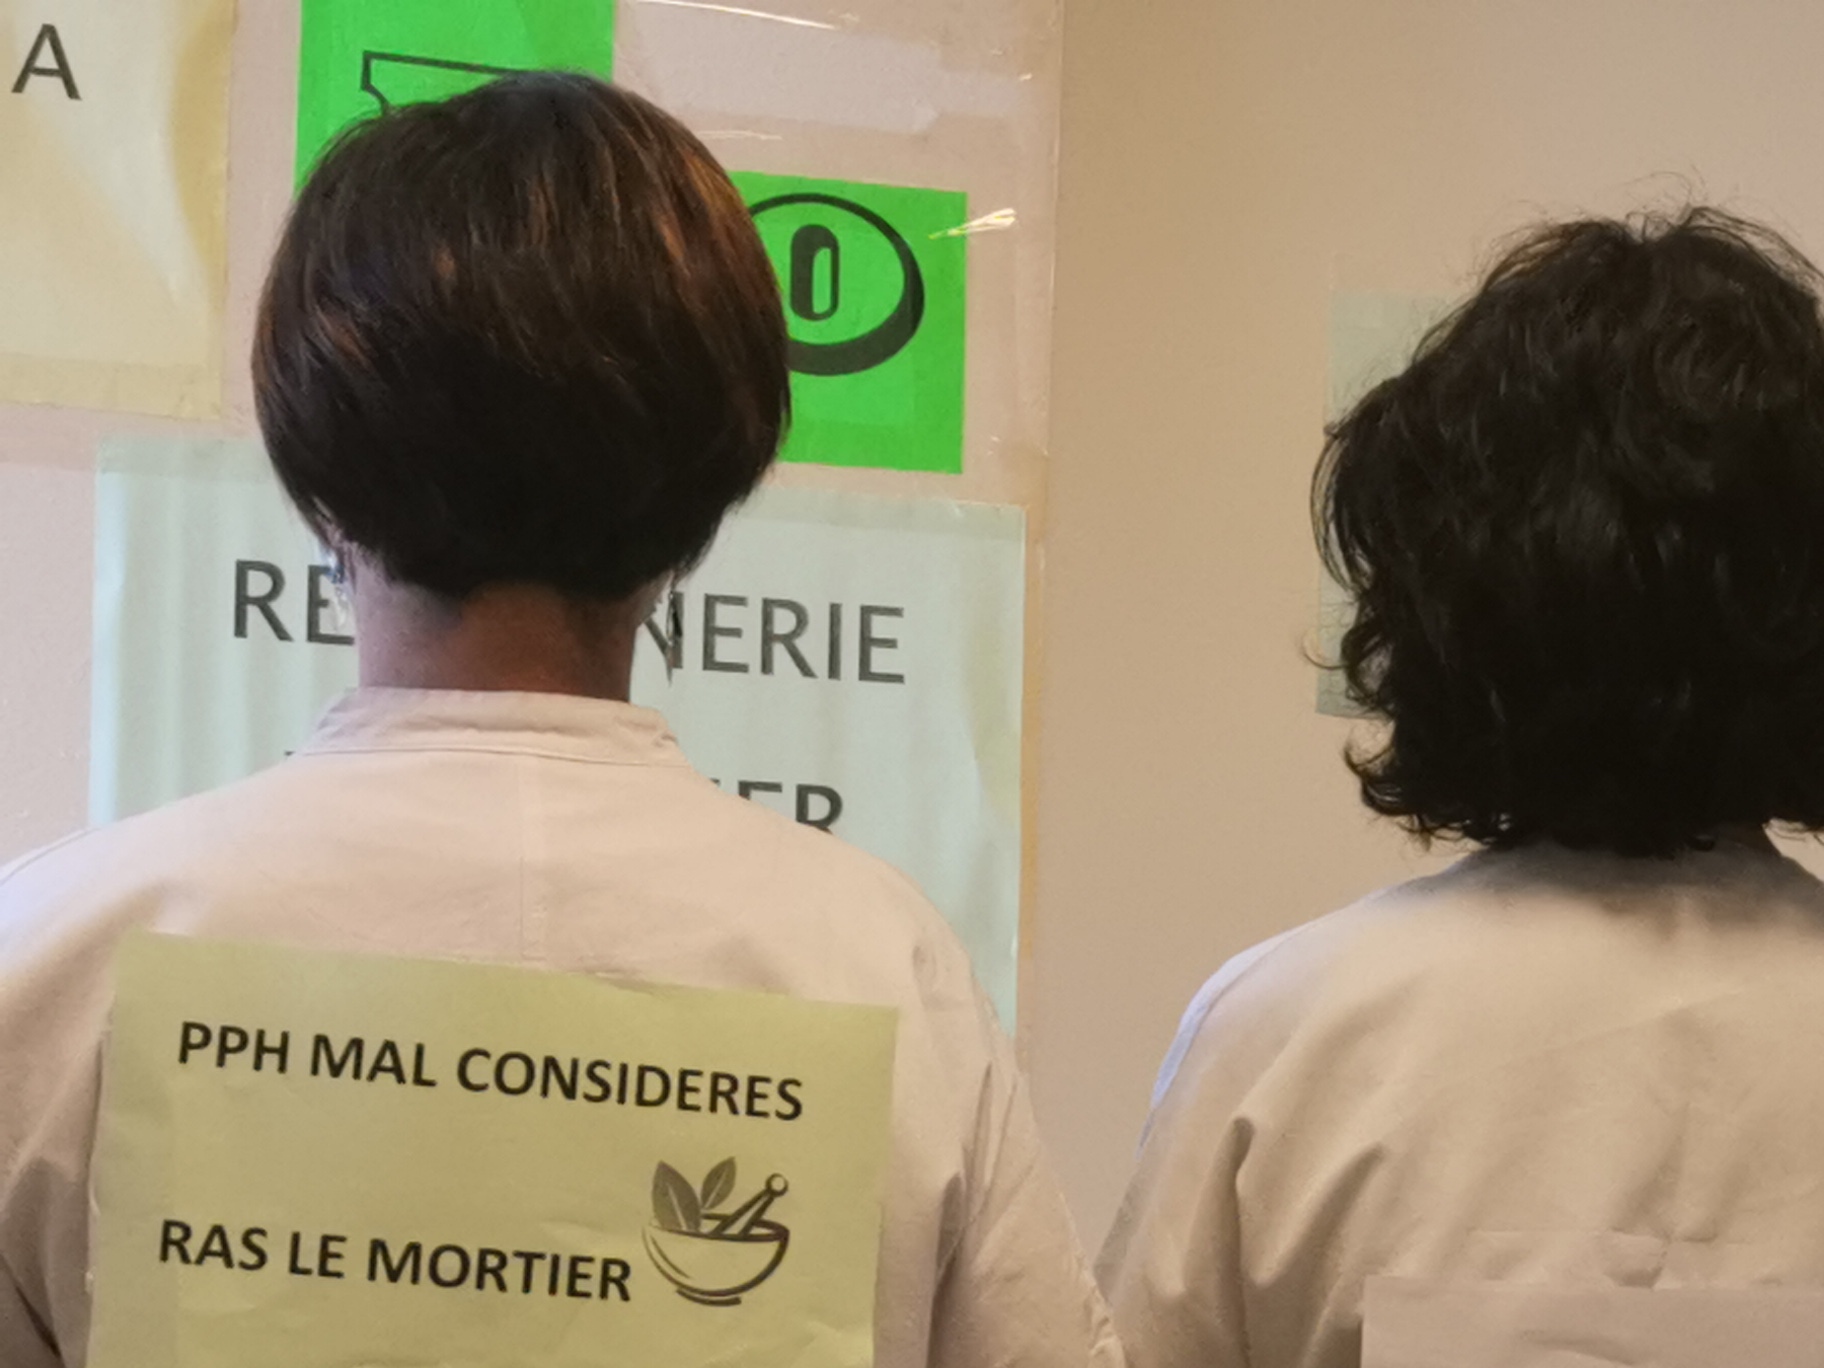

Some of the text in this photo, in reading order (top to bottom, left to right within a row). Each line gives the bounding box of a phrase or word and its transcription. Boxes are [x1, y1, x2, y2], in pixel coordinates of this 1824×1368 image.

[11, 24, 80, 100] A
[178, 1021, 802, 1121] PPH MAL CONSIDERES
[159, 1219, 631, 1302] RAS LE MORTIER
